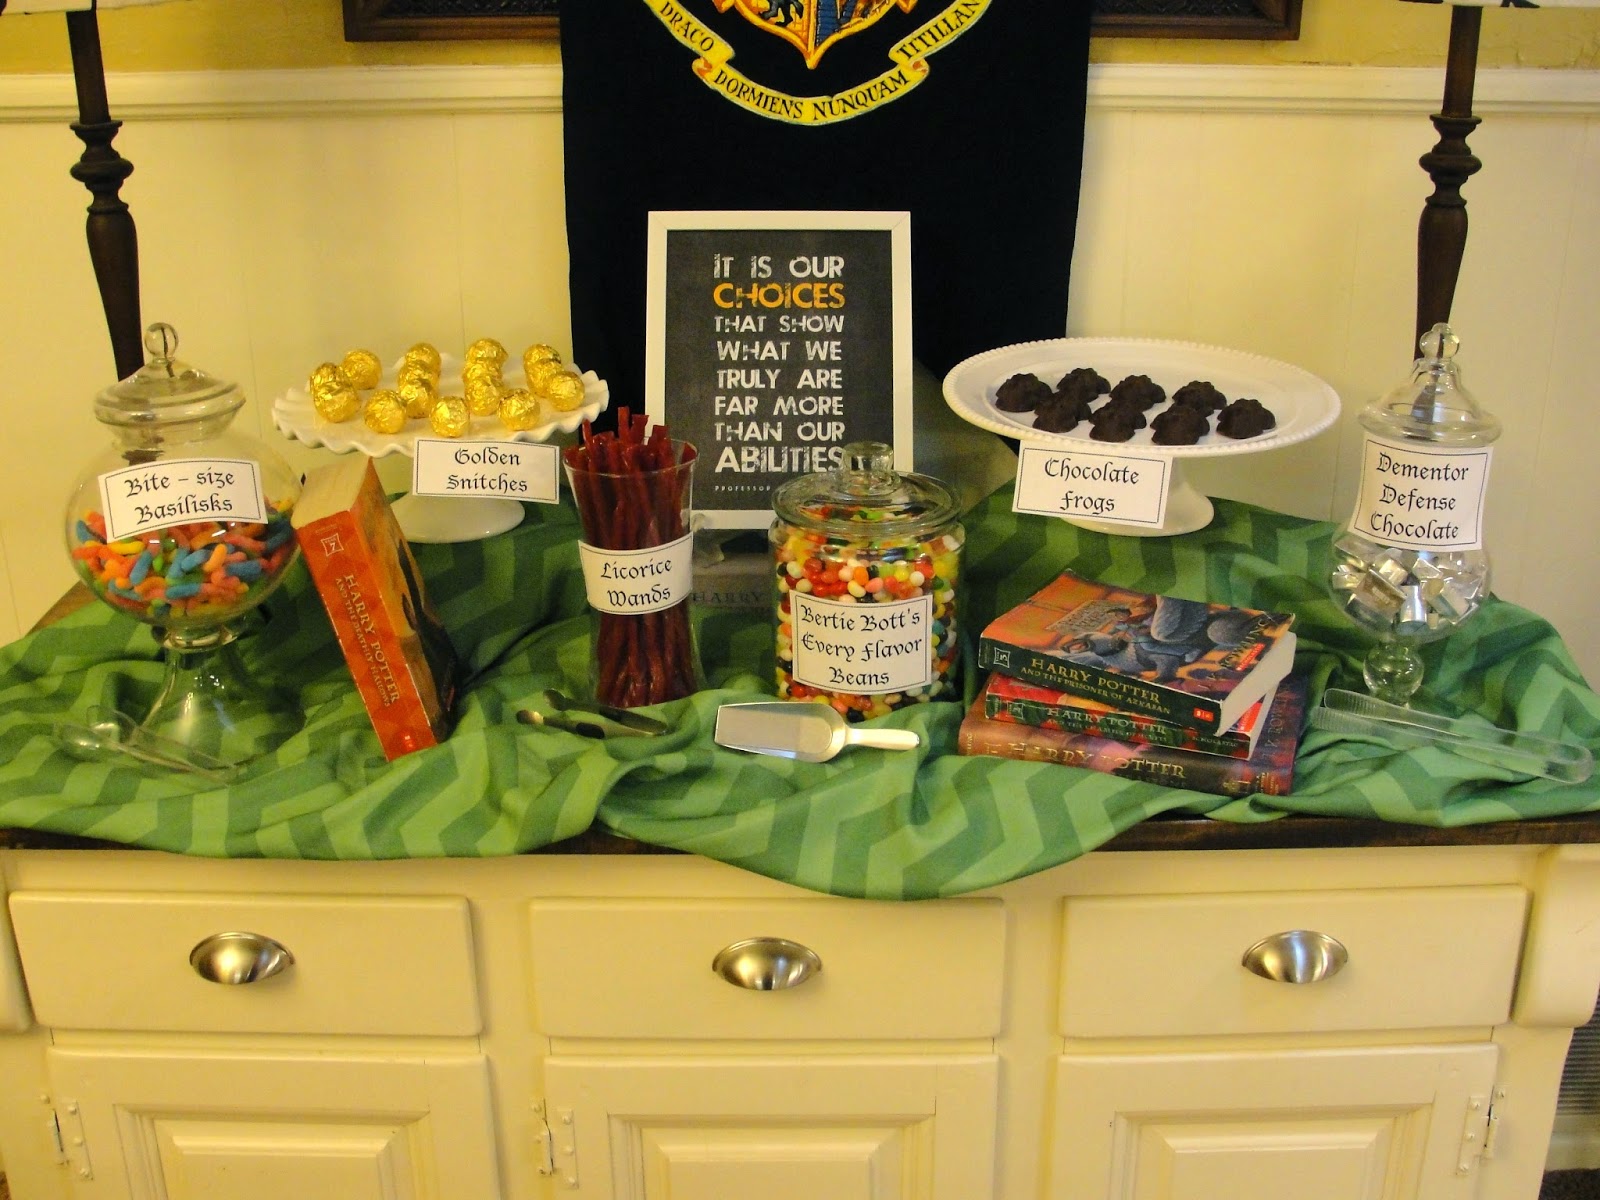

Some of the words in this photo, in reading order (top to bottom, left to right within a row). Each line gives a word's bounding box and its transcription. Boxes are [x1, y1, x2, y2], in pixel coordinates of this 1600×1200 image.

[660, 2, 714, 51] DRACO
[714, 70, 803, 119] DORMIENS
[813, 70, 909, 120] NUNQUAM
[713, 253, 734, 279] IT
[750, 255, 772, 279] IS
[789, 256, 845, 279] OUR
[713, 283, 846, 309] CHOICES
[714, 315, 767, 333] THAT
[779, 315, 845, 333] SHOW
[717, 341, 790, 361] WHAT
[806, 341, 842, 361] WE
[716, 369, 781, 389] TRULY
[797, 369, 842, 389] ARE
[714, 396, 759, 416] FAR
[773, 396, 844, 416] MORE
[714, 422, 783, 442] THAN
[797, 422, 846, 442] OUR
[454, 446, 521, 466] Golden
[714, 447, 846, 473] ABILITIES
[1376, 451, 1469, 481] Dementor
[124, 474, 171, 498] Bite
[197, 466, 236, 489] size
[446, 472, 528, 493] Snitches
[1044, 457, 1140, 485] Chocolate
[134, 493, 234, 525] Basilisks
[1059, 490, 1115, 515] Frogs
[1378, 483, 1456, 512] Defense
[1370, 510, 1459, 539] Chocolate
[601, 558, 673, 580] Licorice
[335, 578, 348, 598] AND
[607, 583, 671, 607] Wands
[691, 592, 764, 603] HARRY
[800, 604, 855, 631] Bertie
[860, 608, 920, 632] Bott's
[345, 574, 376, 635] HARRY
[370, 641, 400, 703] POTTER
[801, 631, 855, 662] Every
[861, 639, 923, 662] Flavor
[829, 666, 890, 686] Beans
[1031, 658, 1092, 682] HARRY
[1098, 677, 1160, 704] POTTER
[1020, 667, 1041, 677] AND
[1042, 673, 1063, 683] THE
[1064, 679, 1108, 697] PRISONER
[1110, 692, 1123, 700] OF
[1126, 697, 1170, 714] AZKABAN
[1046, 707, 1106, 724] HARRY
[1107, 717, 1167, 735] POTTER
[1007, 742, 1095, 762] HARRY
[1101, 755, 1186, 779] POTTER
